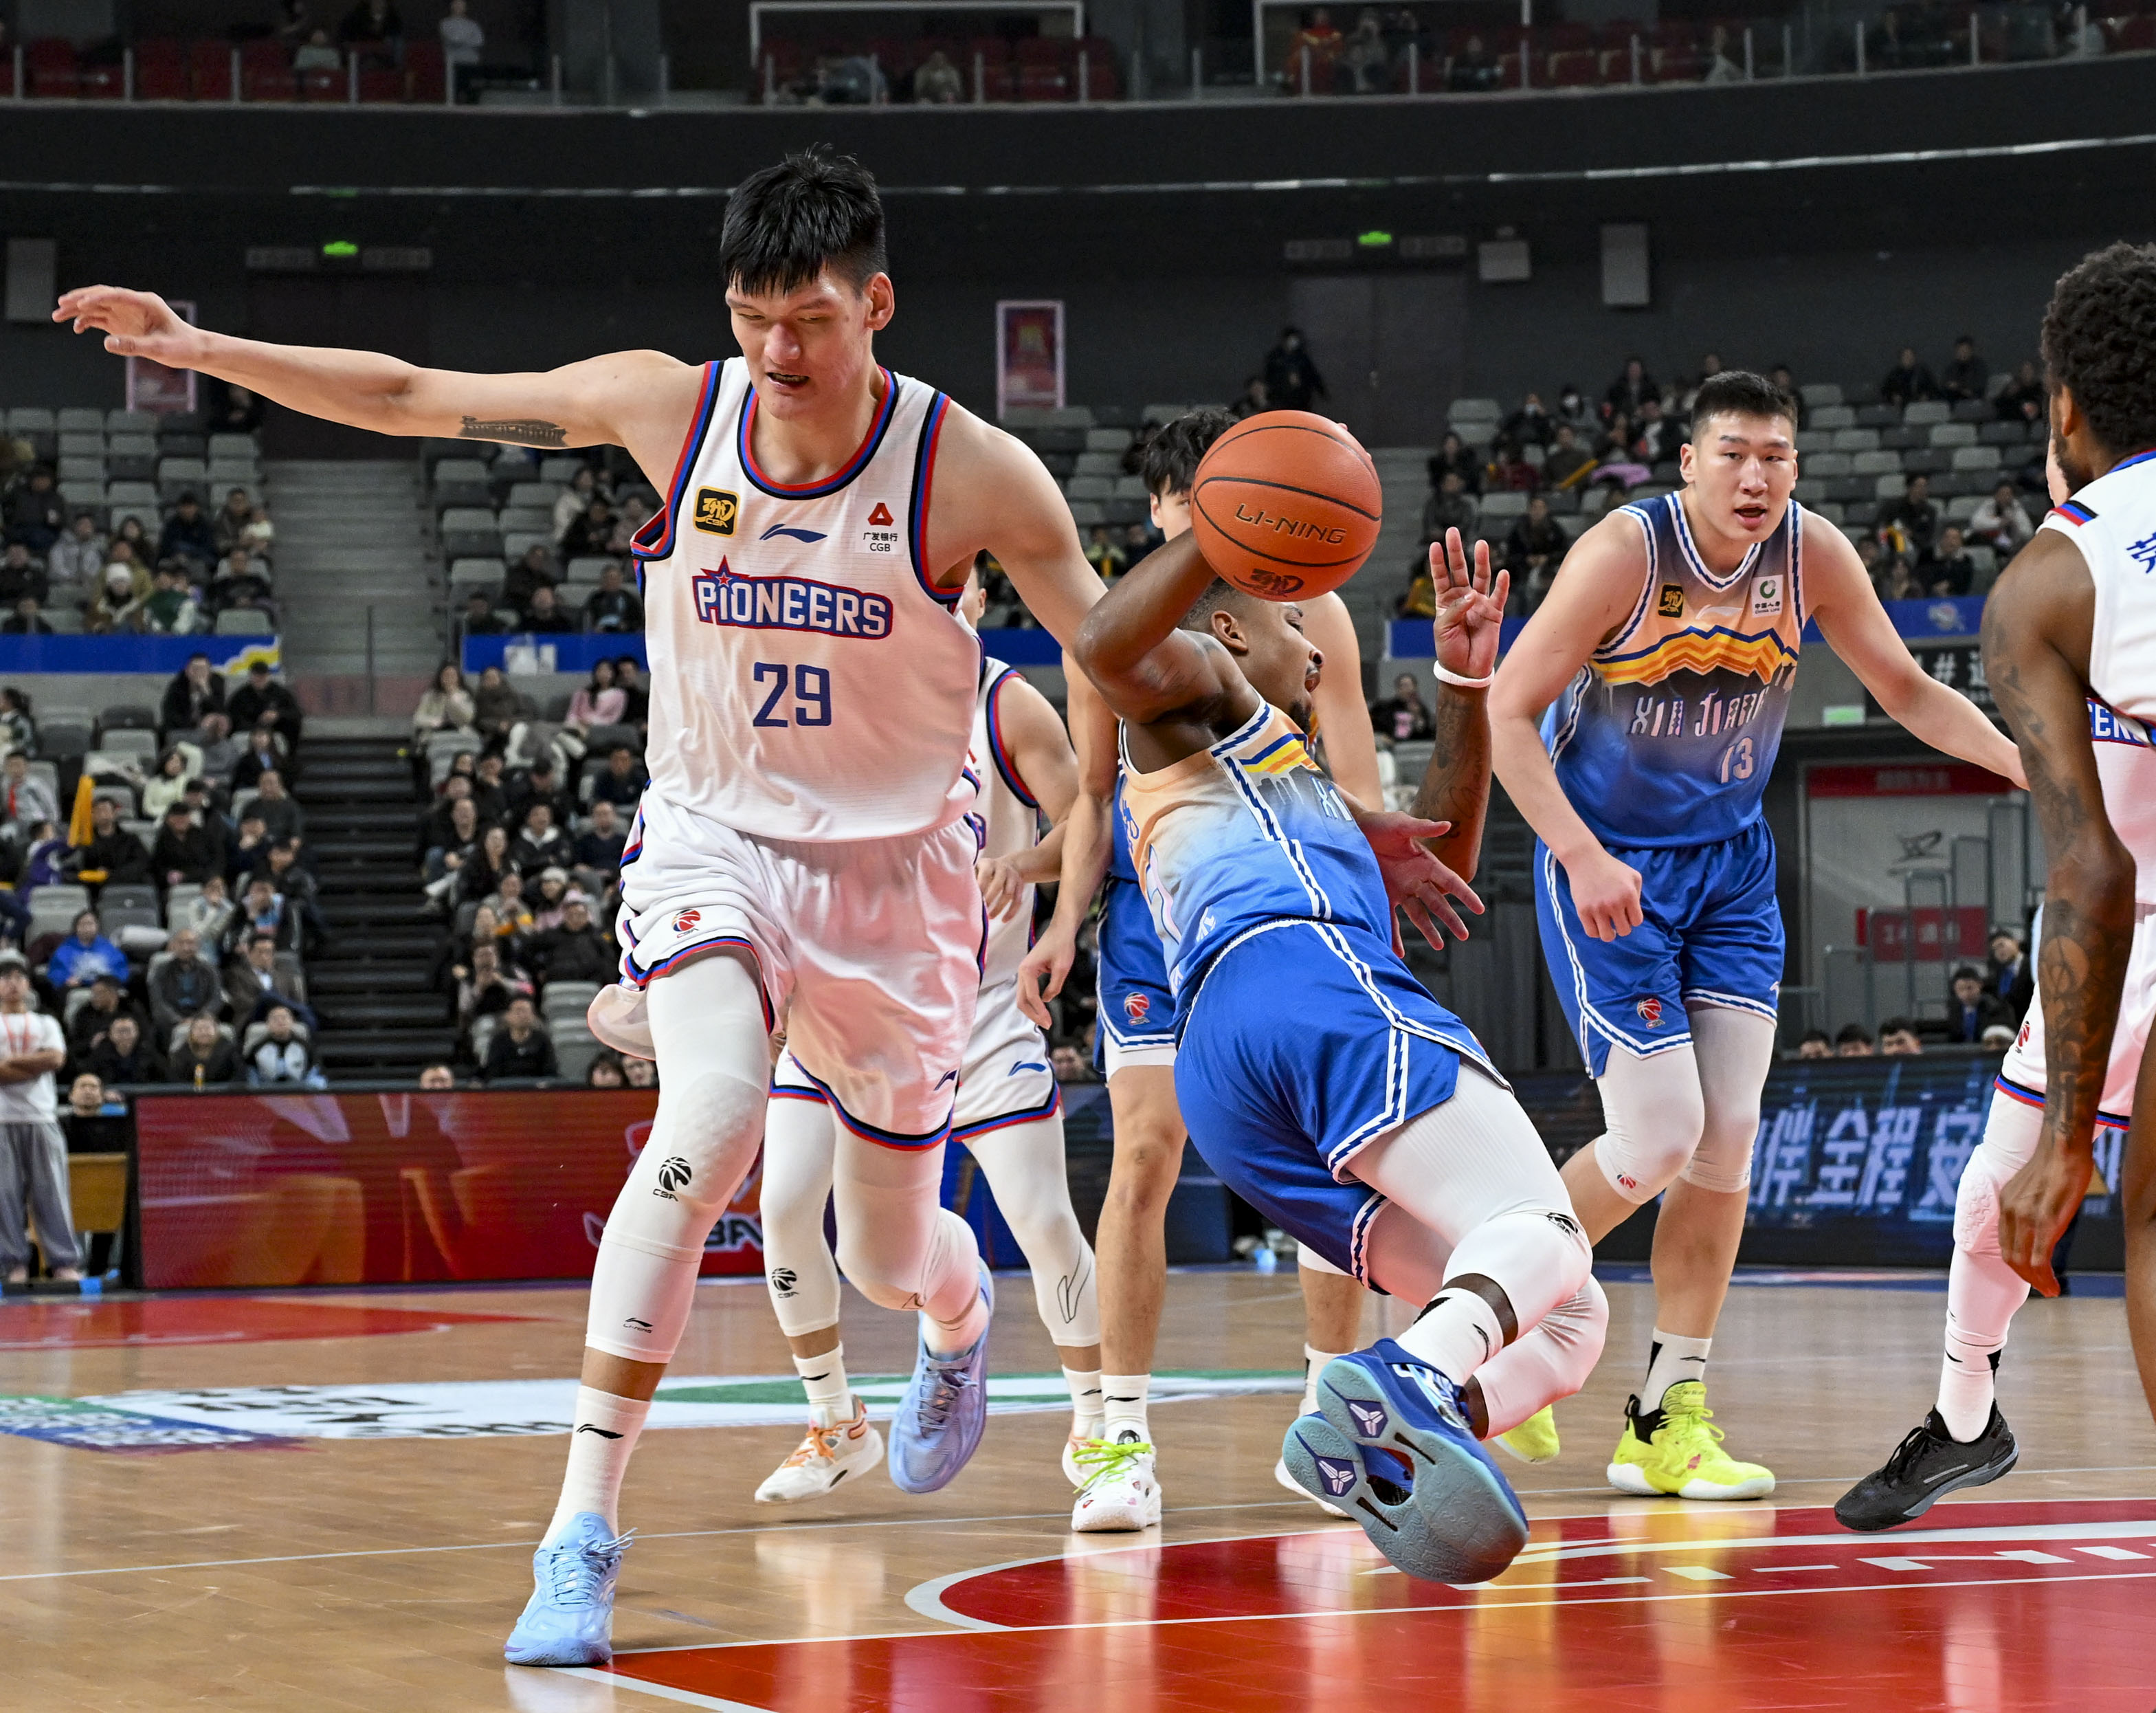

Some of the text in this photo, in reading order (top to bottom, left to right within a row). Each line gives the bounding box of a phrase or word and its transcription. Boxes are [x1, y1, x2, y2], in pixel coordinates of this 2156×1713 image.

[863, 532, 898, 542] 广发银行
[1236, 504, 1346, 544] LI-NING
[869, 542, 891, 552] CGB
[697, 580, 887, 637] PIONEERS
[753, 661, 832, 728] 29
[1720, 736, 1753, 784] 13
[653, 1188, 679, 1202] CBA
[1445, 1543, 2156, 1591] LI-NI
